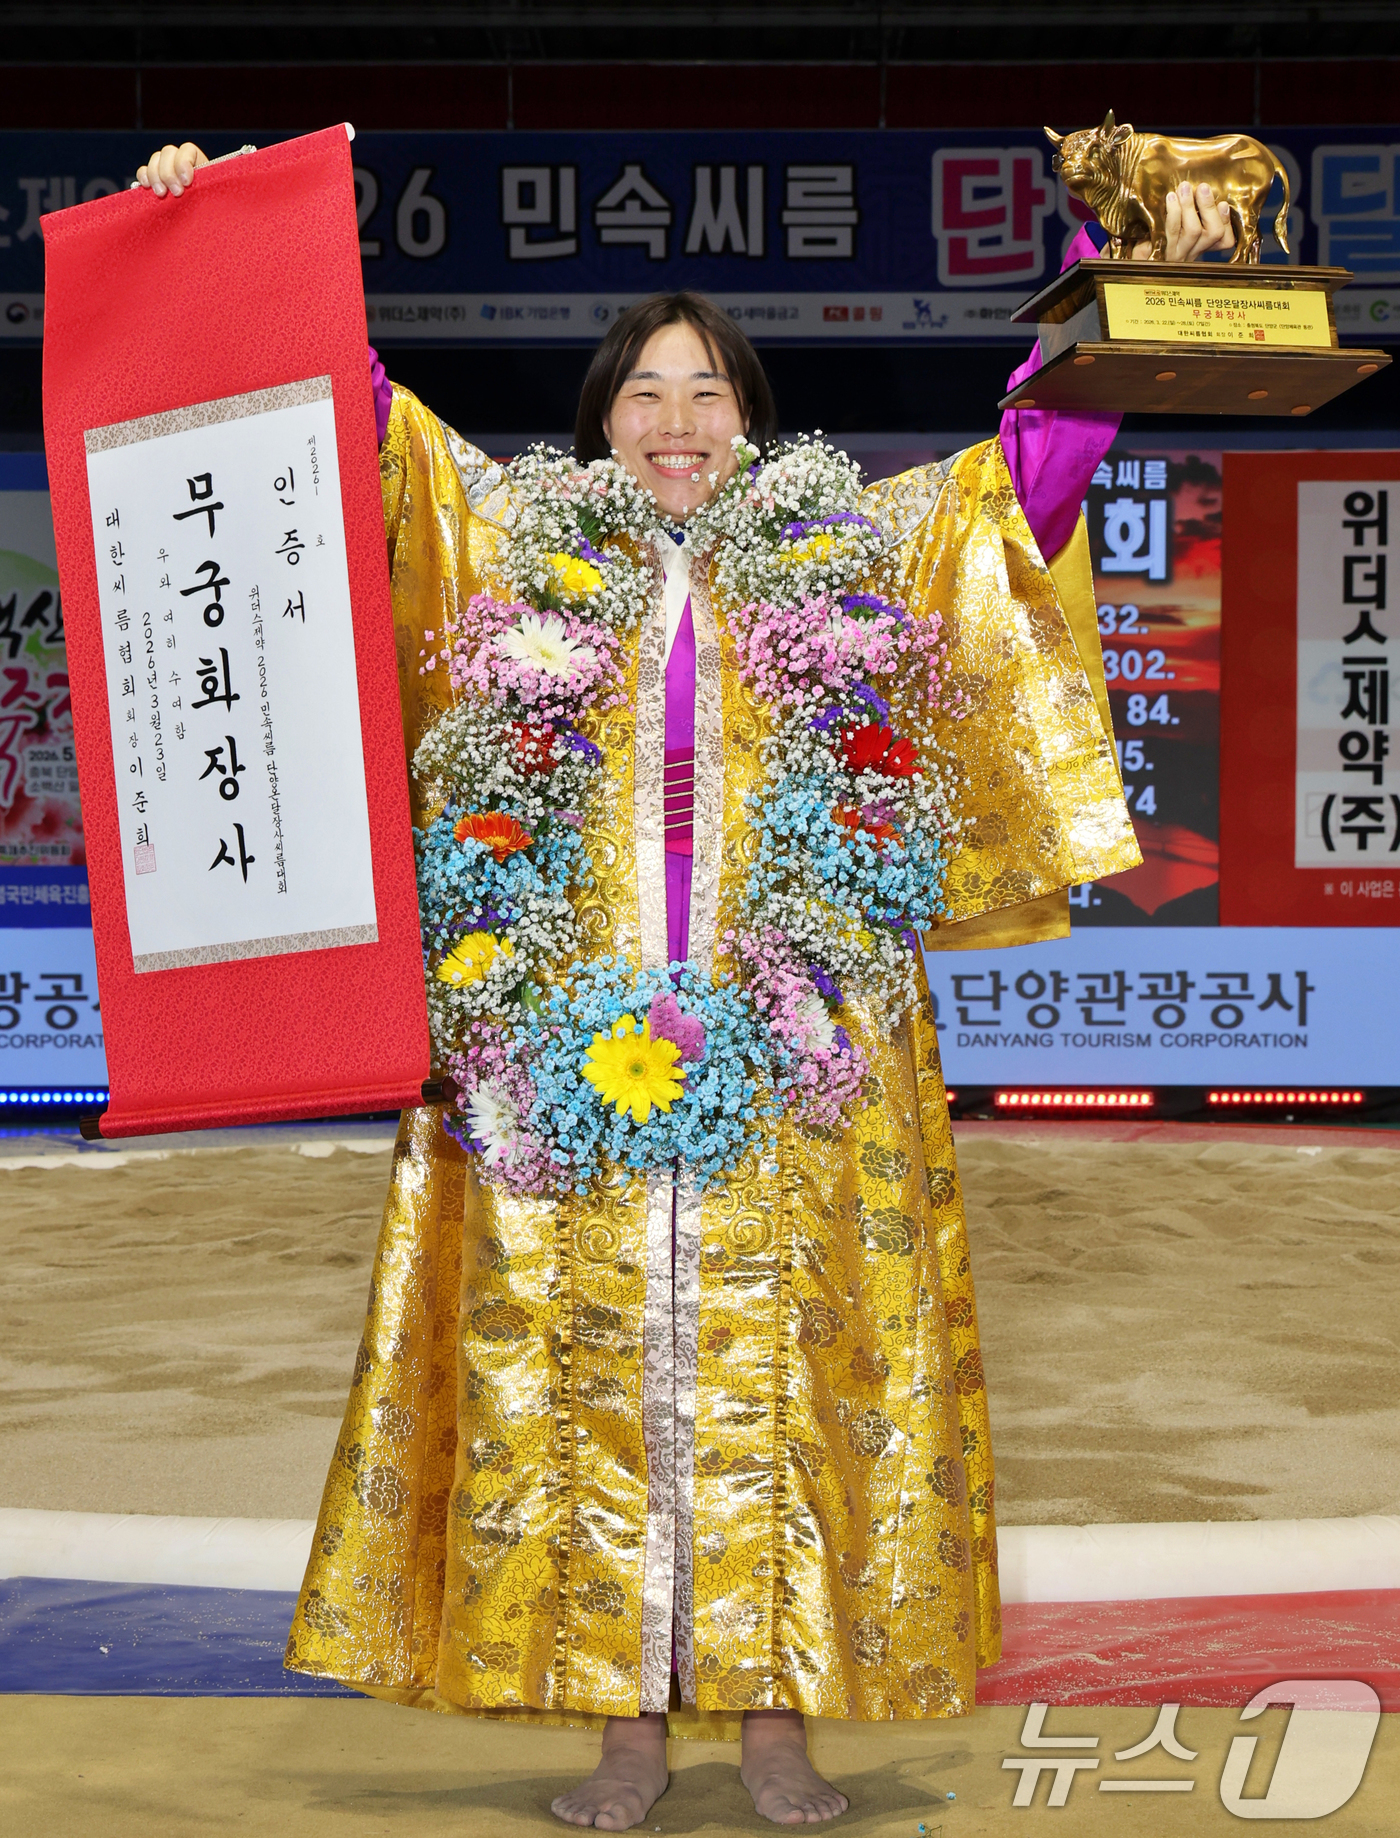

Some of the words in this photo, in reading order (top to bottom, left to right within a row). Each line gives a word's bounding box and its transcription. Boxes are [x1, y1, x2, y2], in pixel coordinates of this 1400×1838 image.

[503, 166, 858, 258] 민속씨름
[500, 306, 524, 320] IBK
[1145, 297, 1166, 306] 2026
[1168, 297, 1202, 308] 민속씨름
[1206, 298, 1290, 310] 단양온달장사씨름대회
[1192, 309, 1246, 320] 무궁화장사
[1178, 330, 1213, 338] 대한씨름협회
[273, 466, 306, 624] 인증서
[1081, 498, 1167, 579] 회
[105, 508, 135, 697] 대한씨름협회
[248, 584, 265, 650] 위더스제약
[172, 472, 256, 884] 무궁화장사
[257, 656, 268, 698] 2026
[1102, 649, 1175, 680] 302.
[260, 701, 276, 756] 민속씨름
[1126, 693, 1180, 726] 84.
[1340, 881, 1353, 898] 이
[1357, 881, 1395, 898] 사업은
[951, 969, 1315, 1030] 단양관광공사
[957, 1033, 1054, 1048] DANYANG
[1061, 1033, 1152, 1048] TOURISM
[1160, 1033, 1309, 1048] CORPORATION
